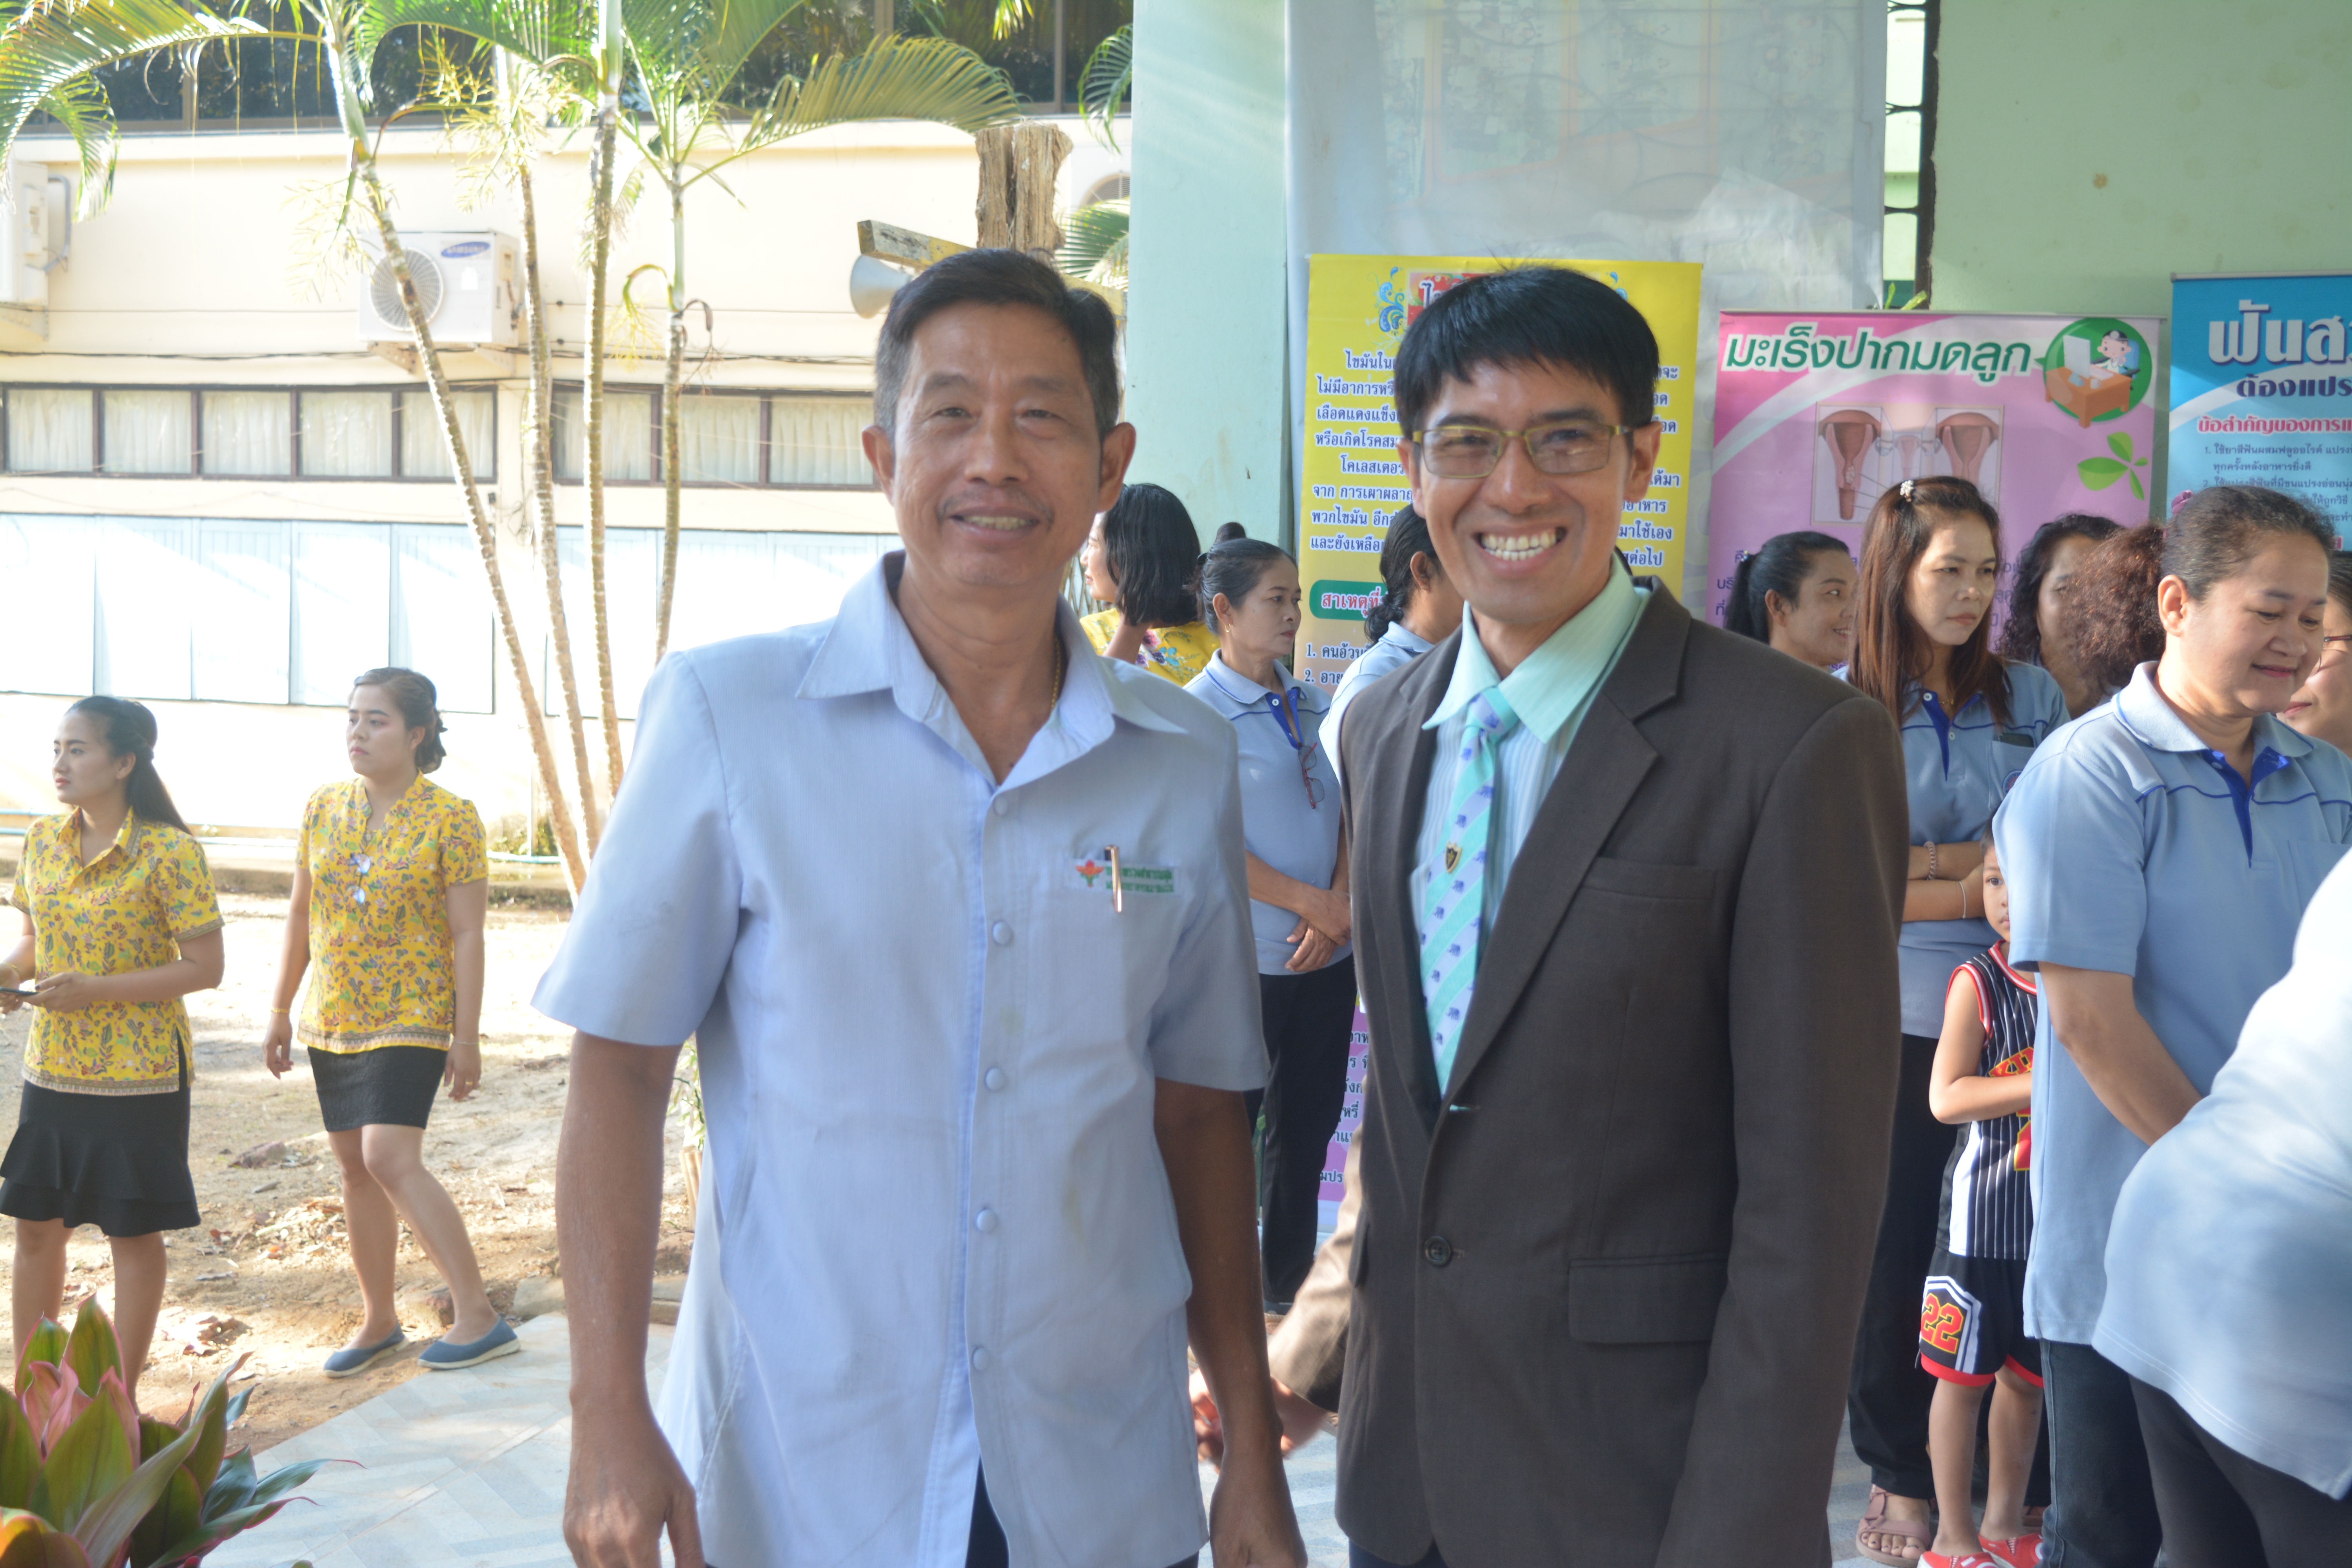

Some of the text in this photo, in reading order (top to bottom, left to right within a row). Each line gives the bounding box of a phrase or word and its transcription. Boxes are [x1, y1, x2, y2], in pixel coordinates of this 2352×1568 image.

[2209, 299, 2352, 364] ฟันส
[1726, 326, 2031, 383] มะเร็งปากมดลูก
[1650, 469, 1680, 486] ด้มา
[1314, 486, 1334, 497] จาก
[1312, 506, 1367, 525] พวกไขมัน
[1322, 588, 1379, 616] สาเหตุที่
[1307, 644, 1316, 657] 1.
[1305, 670, 1314, 682] 2.
[1921, 1292, 1964, 1354] 22
